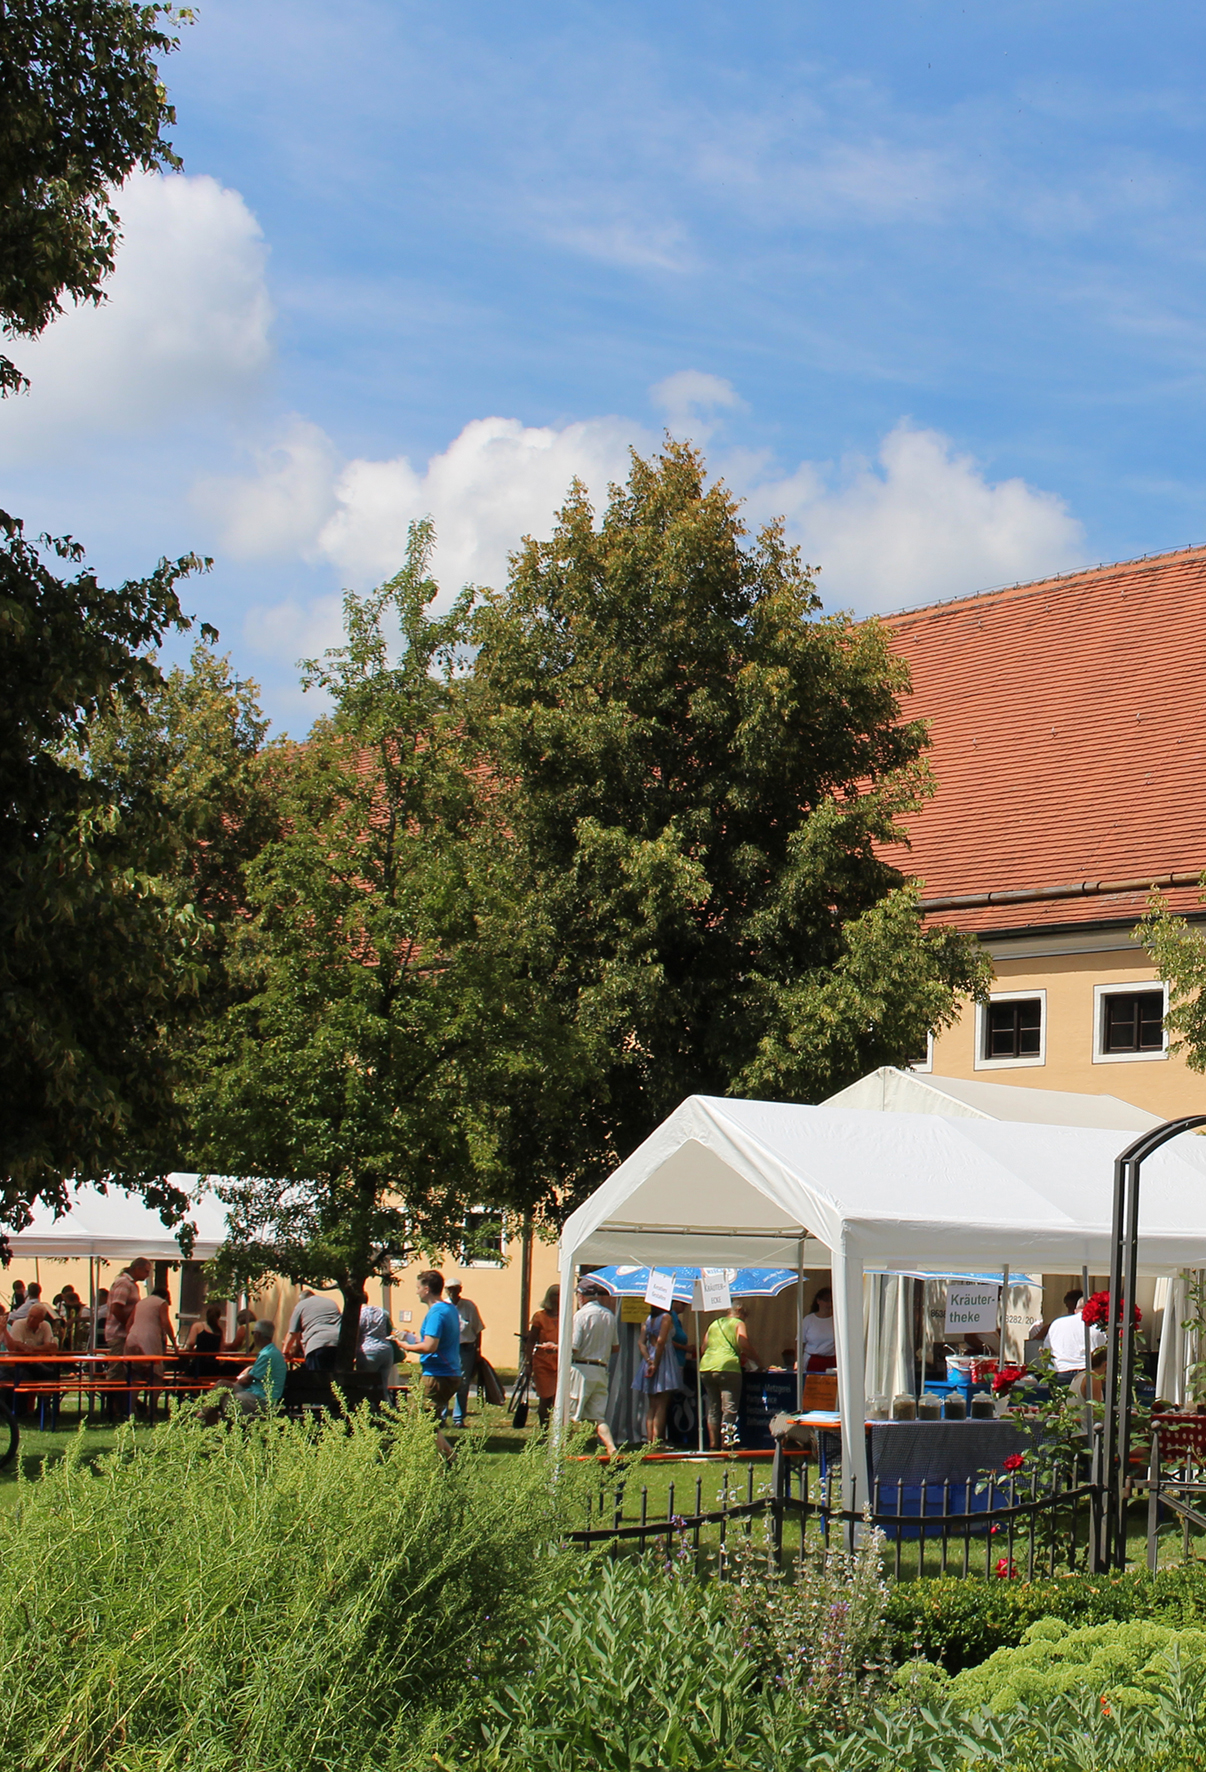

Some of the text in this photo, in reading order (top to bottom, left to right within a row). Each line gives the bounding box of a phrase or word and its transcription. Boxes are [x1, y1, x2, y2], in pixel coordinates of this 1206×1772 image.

[711, 1296, 722, 1304] ECKE
[950, 1293, 996, 1306] Kräuter-
[949, 1311, 980, 1323] theke
